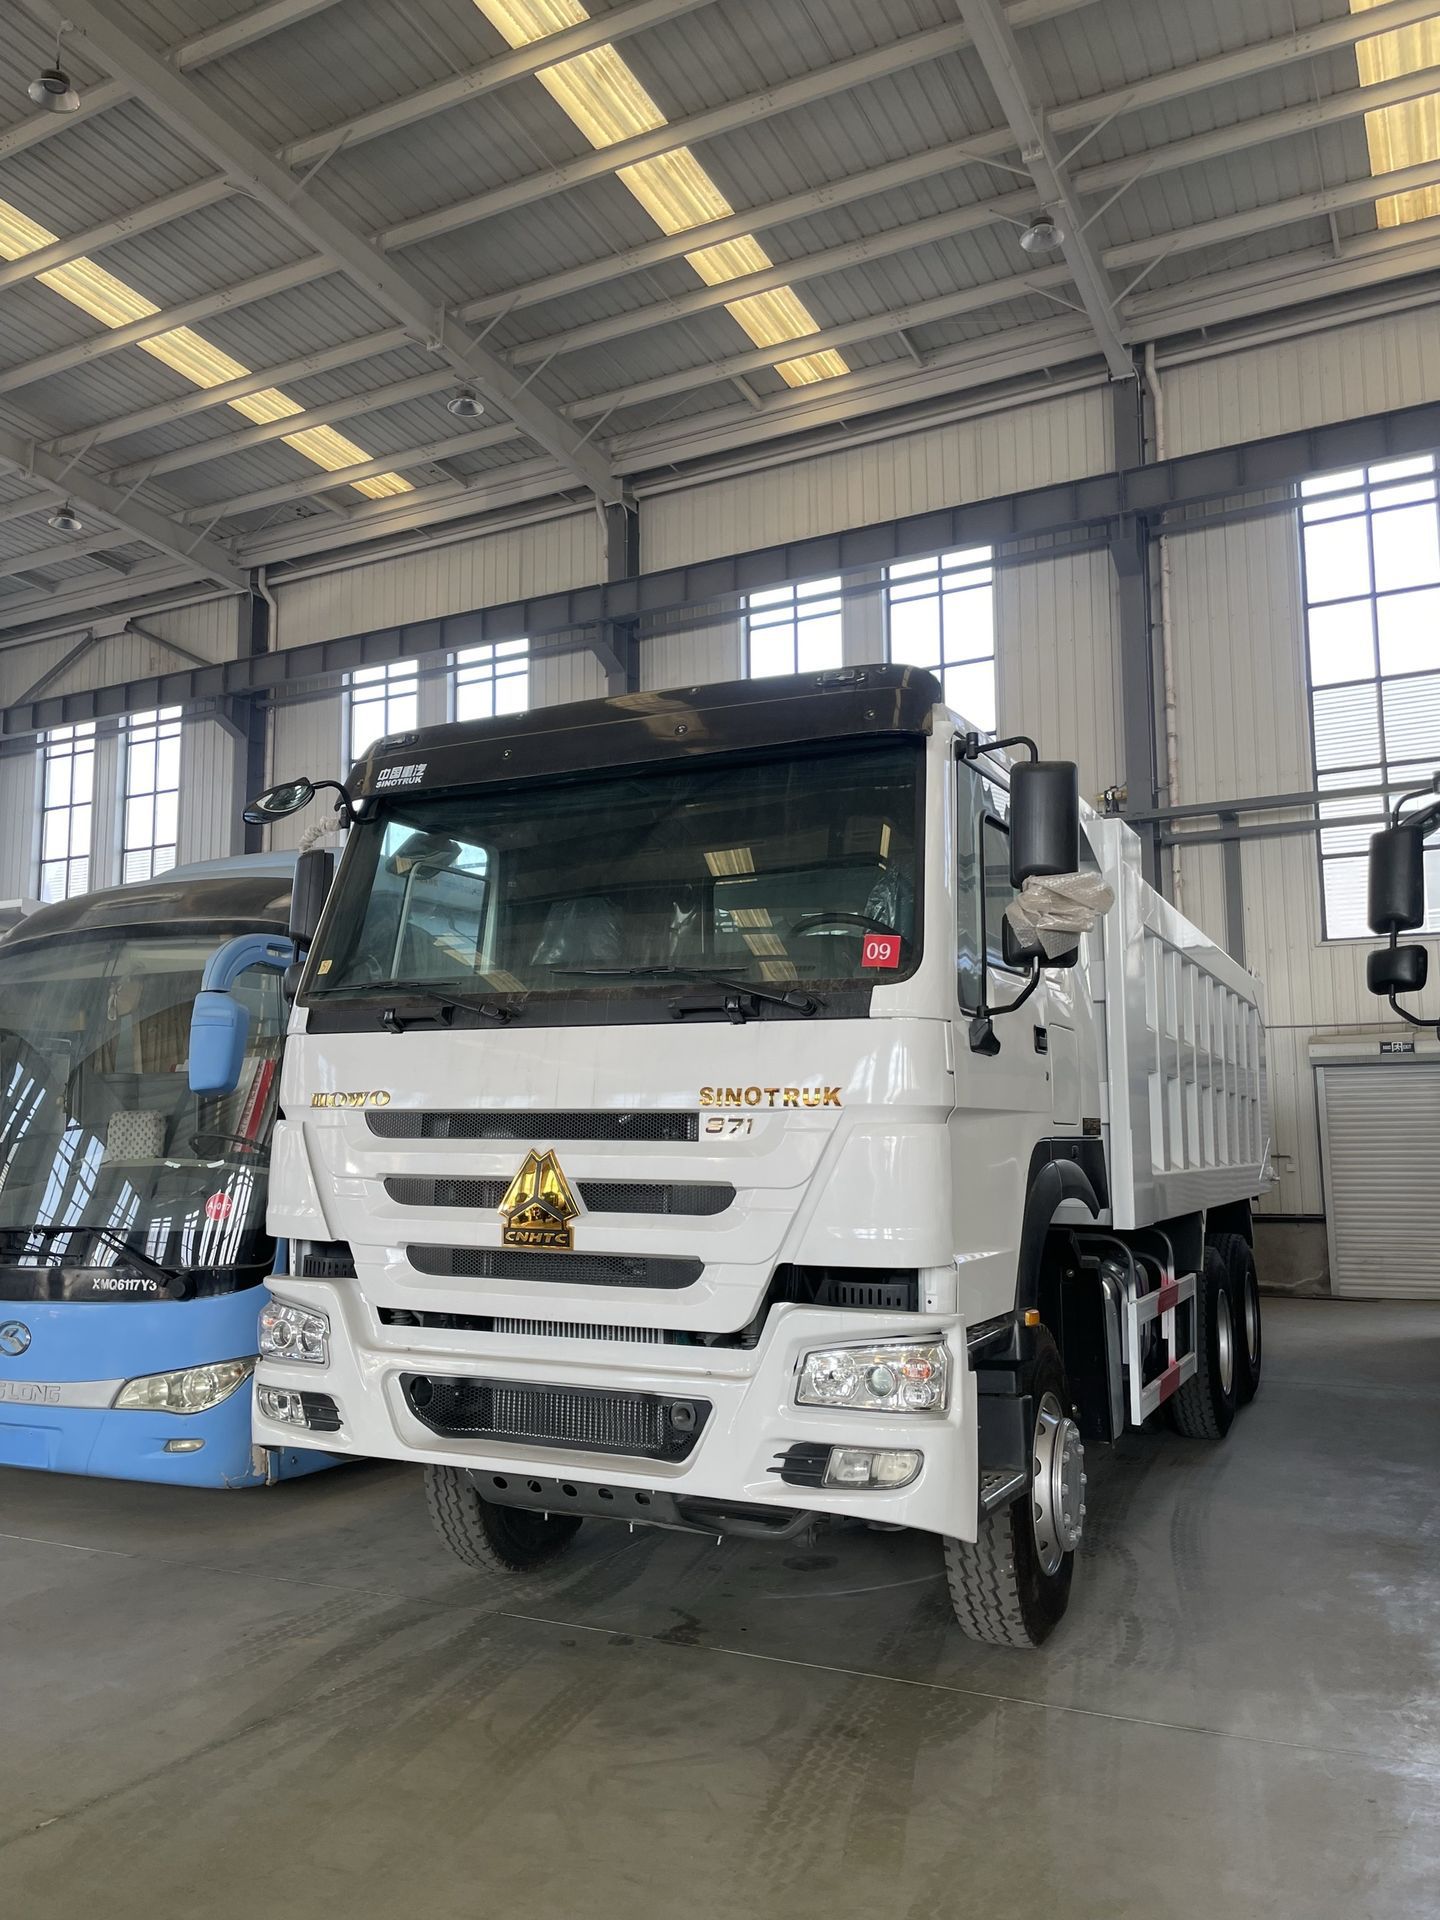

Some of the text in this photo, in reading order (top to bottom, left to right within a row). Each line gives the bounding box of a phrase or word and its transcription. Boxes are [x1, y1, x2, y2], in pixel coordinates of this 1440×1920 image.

[376, 776, 422, 788] SINOTRUK
[867, 943, 891, 960] 09
[700, 1087, 842, 1107] SINOTRUK
[505, 1231, 568, 1243] CNHTC
[92, 1279, 157, 1291] XMQ6117Y3
